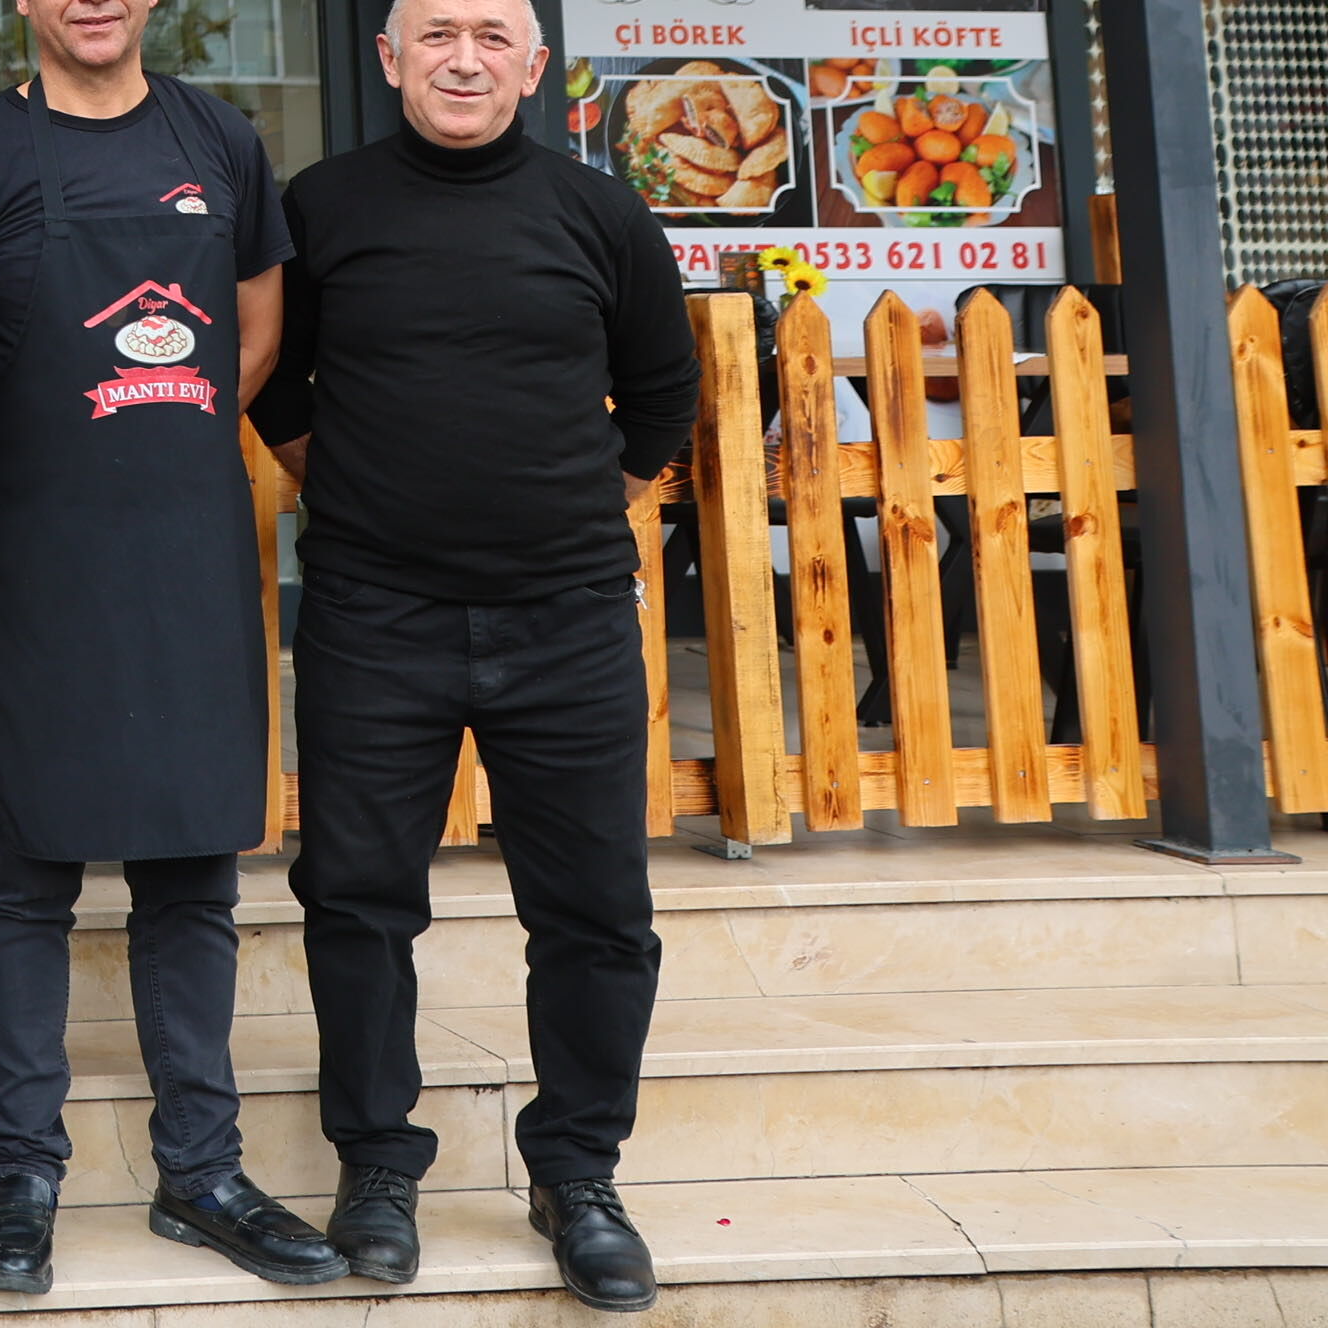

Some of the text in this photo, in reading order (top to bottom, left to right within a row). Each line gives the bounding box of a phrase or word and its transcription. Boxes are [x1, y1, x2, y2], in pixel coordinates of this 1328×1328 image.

[615, 18, 746, 49] Çİ BÖREK
[850, 20, 1002, 51] İÇLİ KÖFTE
[887, 241, 942, 269] 621
[959, 241, 998, 270] 02
[1012, 241, 1047, 270] 81
[137, 297, 168, 314] Diyar
[107, 381, 205, 403] MANTI EVİ
